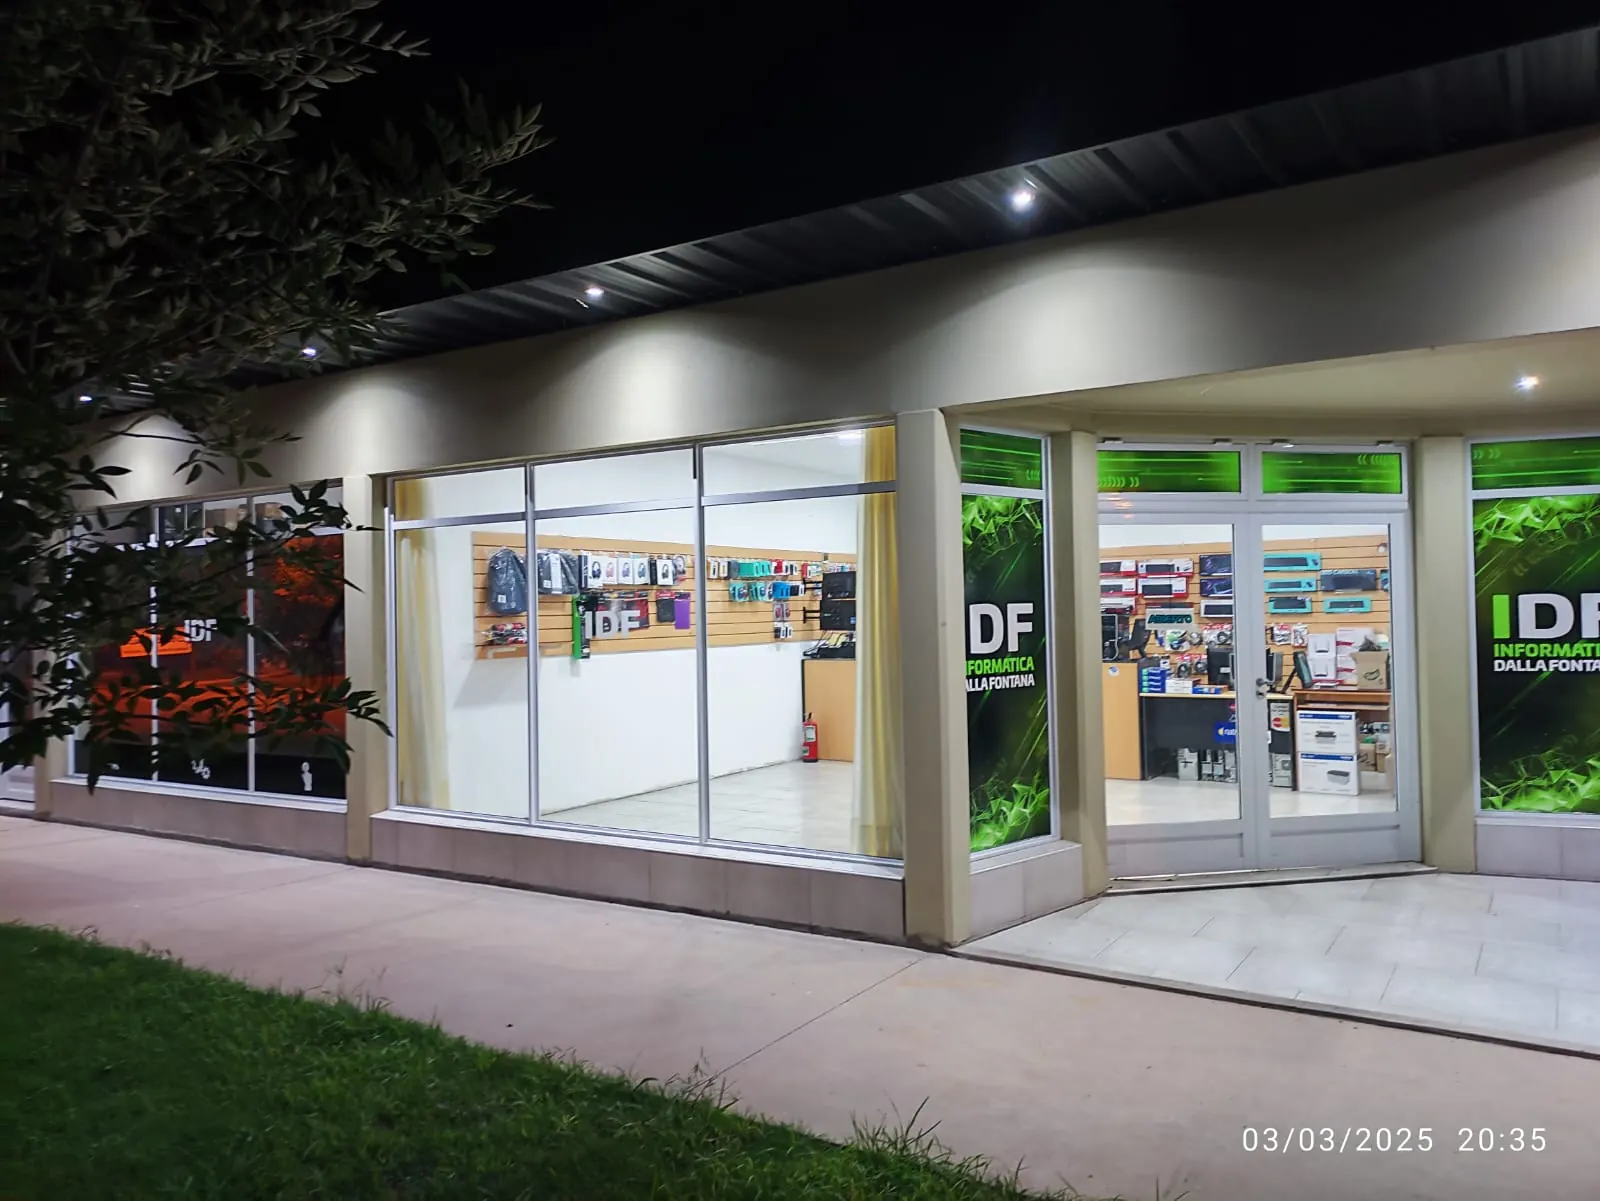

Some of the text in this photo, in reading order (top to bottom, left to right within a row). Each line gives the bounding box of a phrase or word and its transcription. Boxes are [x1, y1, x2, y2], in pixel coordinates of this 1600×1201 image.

[184, 618, 218, 642] IDF
[584, 610, 641, 640] IDF
[969, 602, 1034, 655] DF
[965, 656, 1035, 676] FORMATICA
